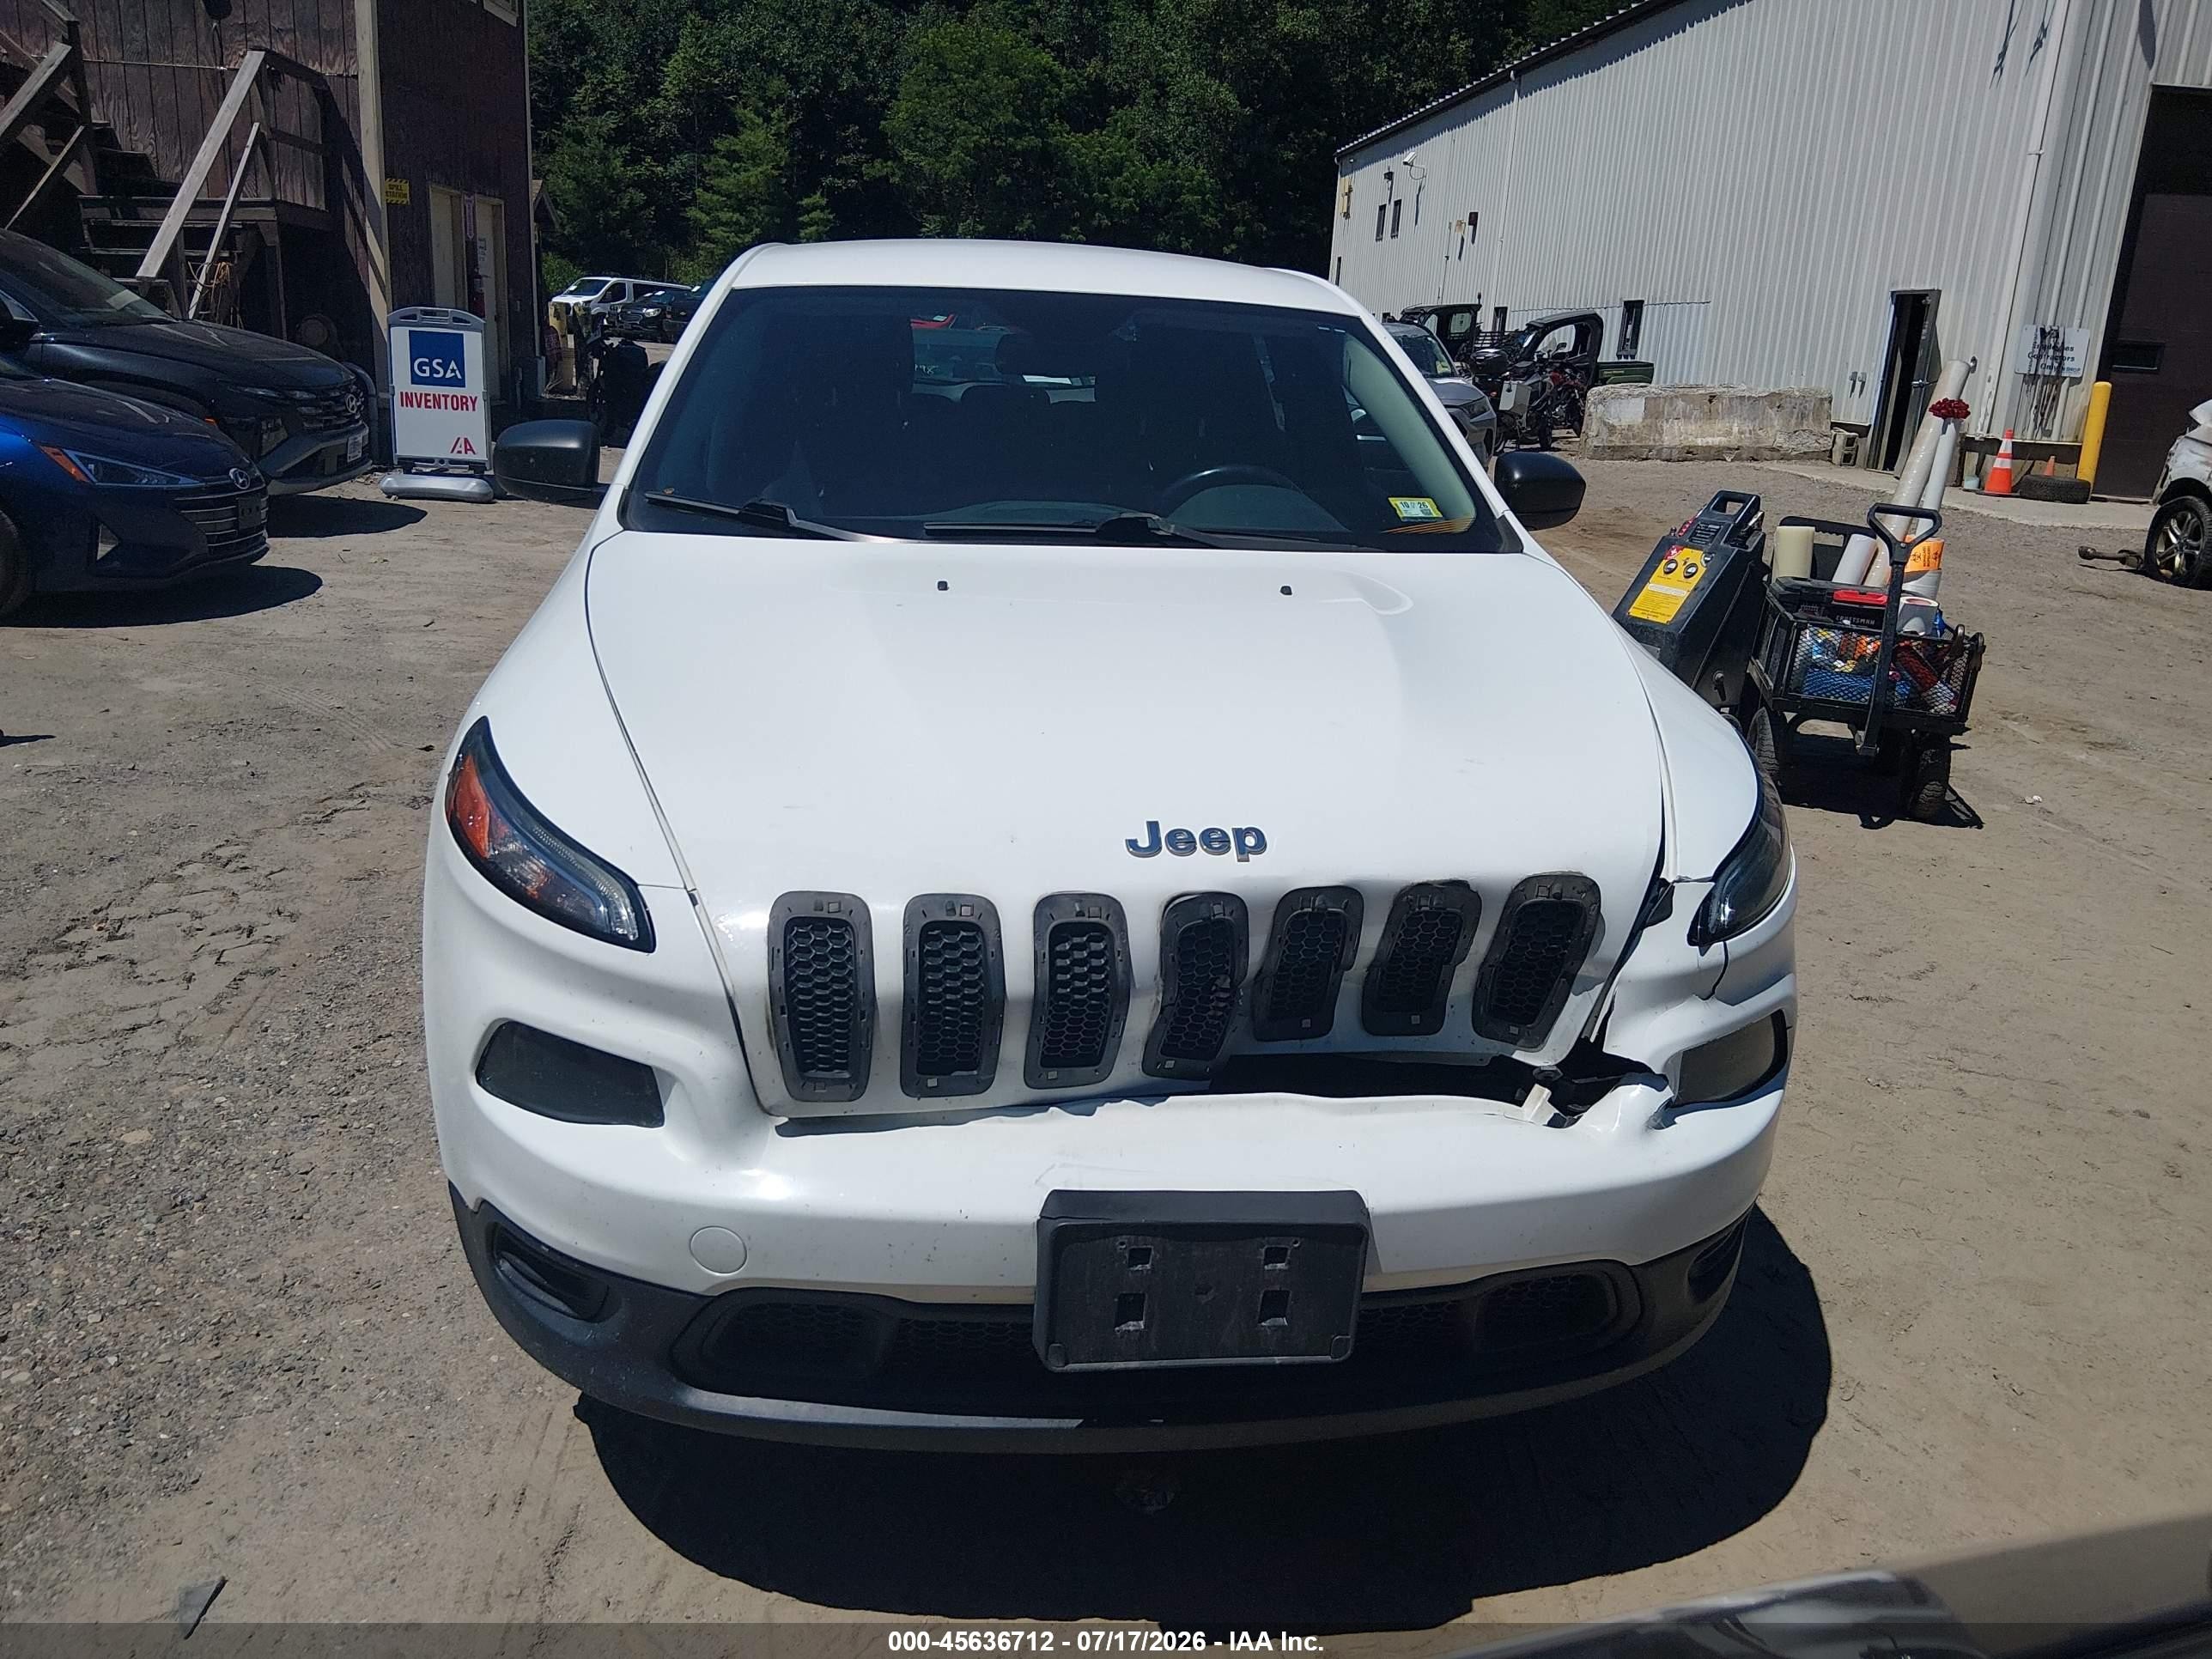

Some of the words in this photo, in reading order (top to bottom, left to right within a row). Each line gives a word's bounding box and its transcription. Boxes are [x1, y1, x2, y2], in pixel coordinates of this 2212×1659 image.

[413, 357, 462, 380] GSA
[399, 391, 477, 411] INVENTORY
[1125, 821, 1267, 862] Jeep
